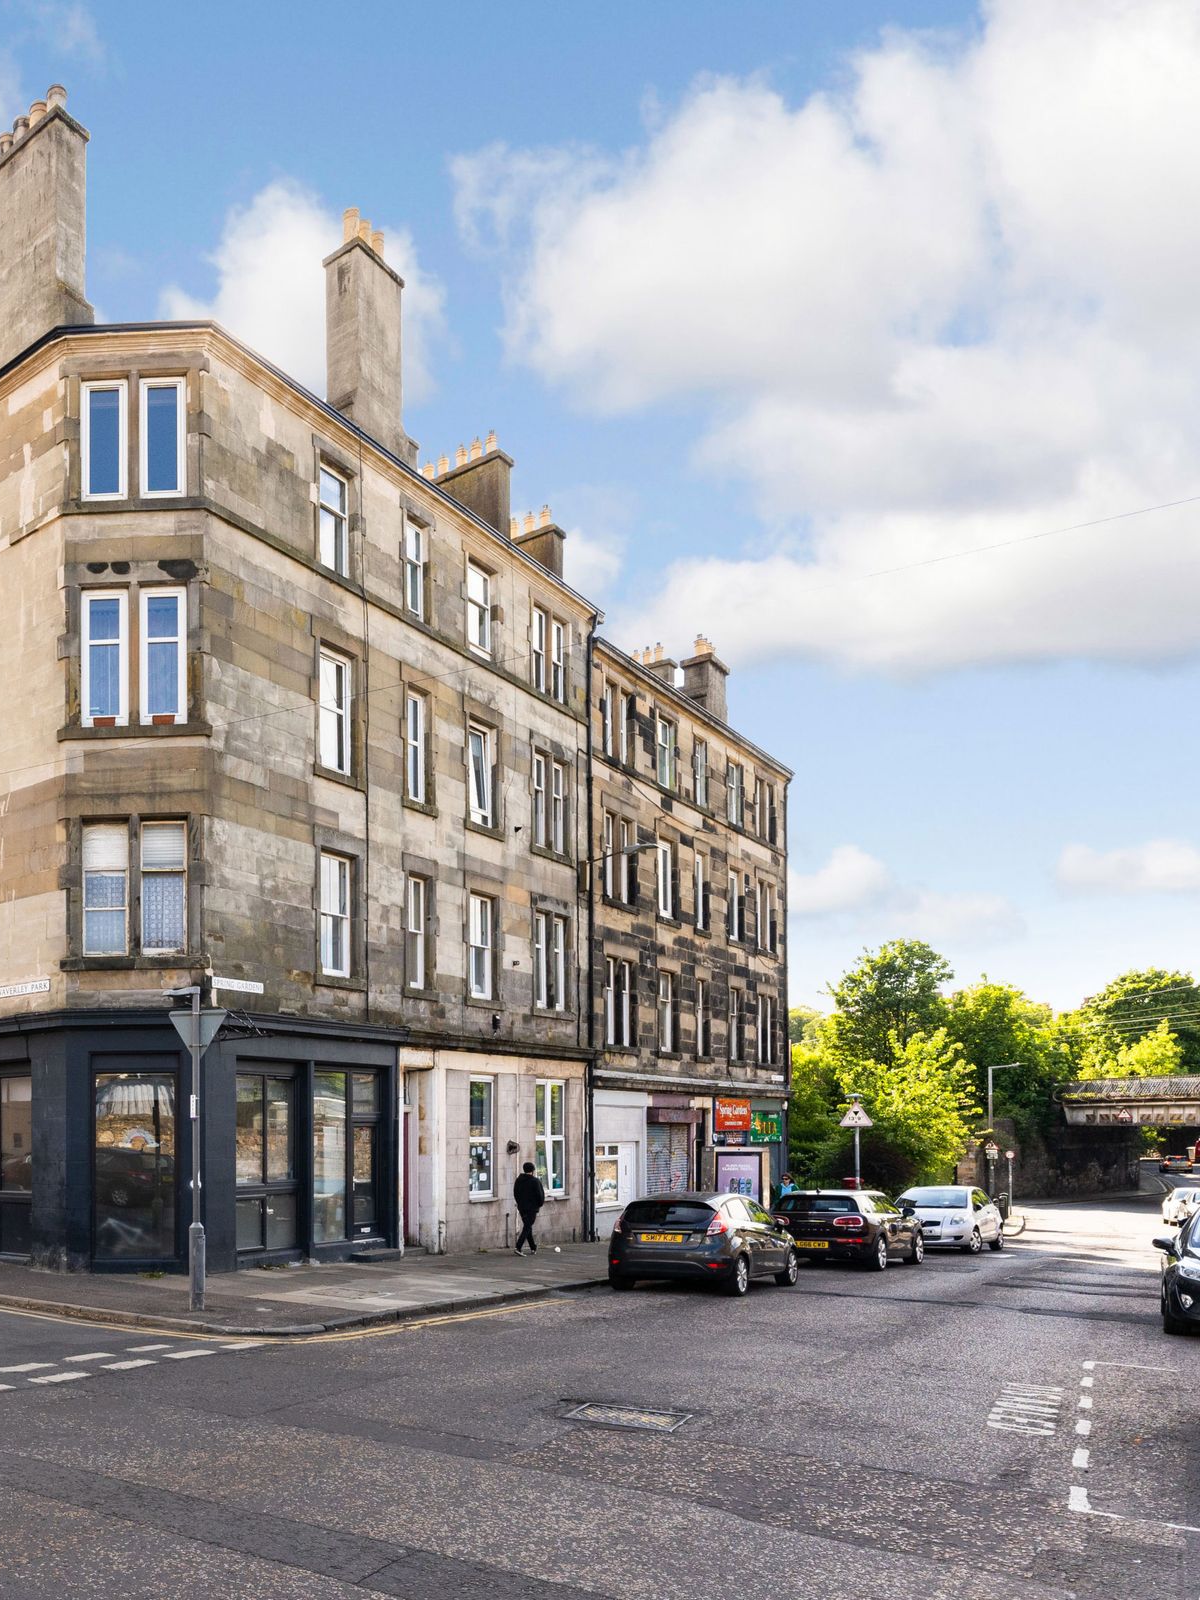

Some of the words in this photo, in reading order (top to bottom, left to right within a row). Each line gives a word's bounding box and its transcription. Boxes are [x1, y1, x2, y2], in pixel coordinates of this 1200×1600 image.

[31, 982, 48, 991] PARK
[213, 979, 235, 988] SPRING
[236, 982, 263, 992] GARDENS
